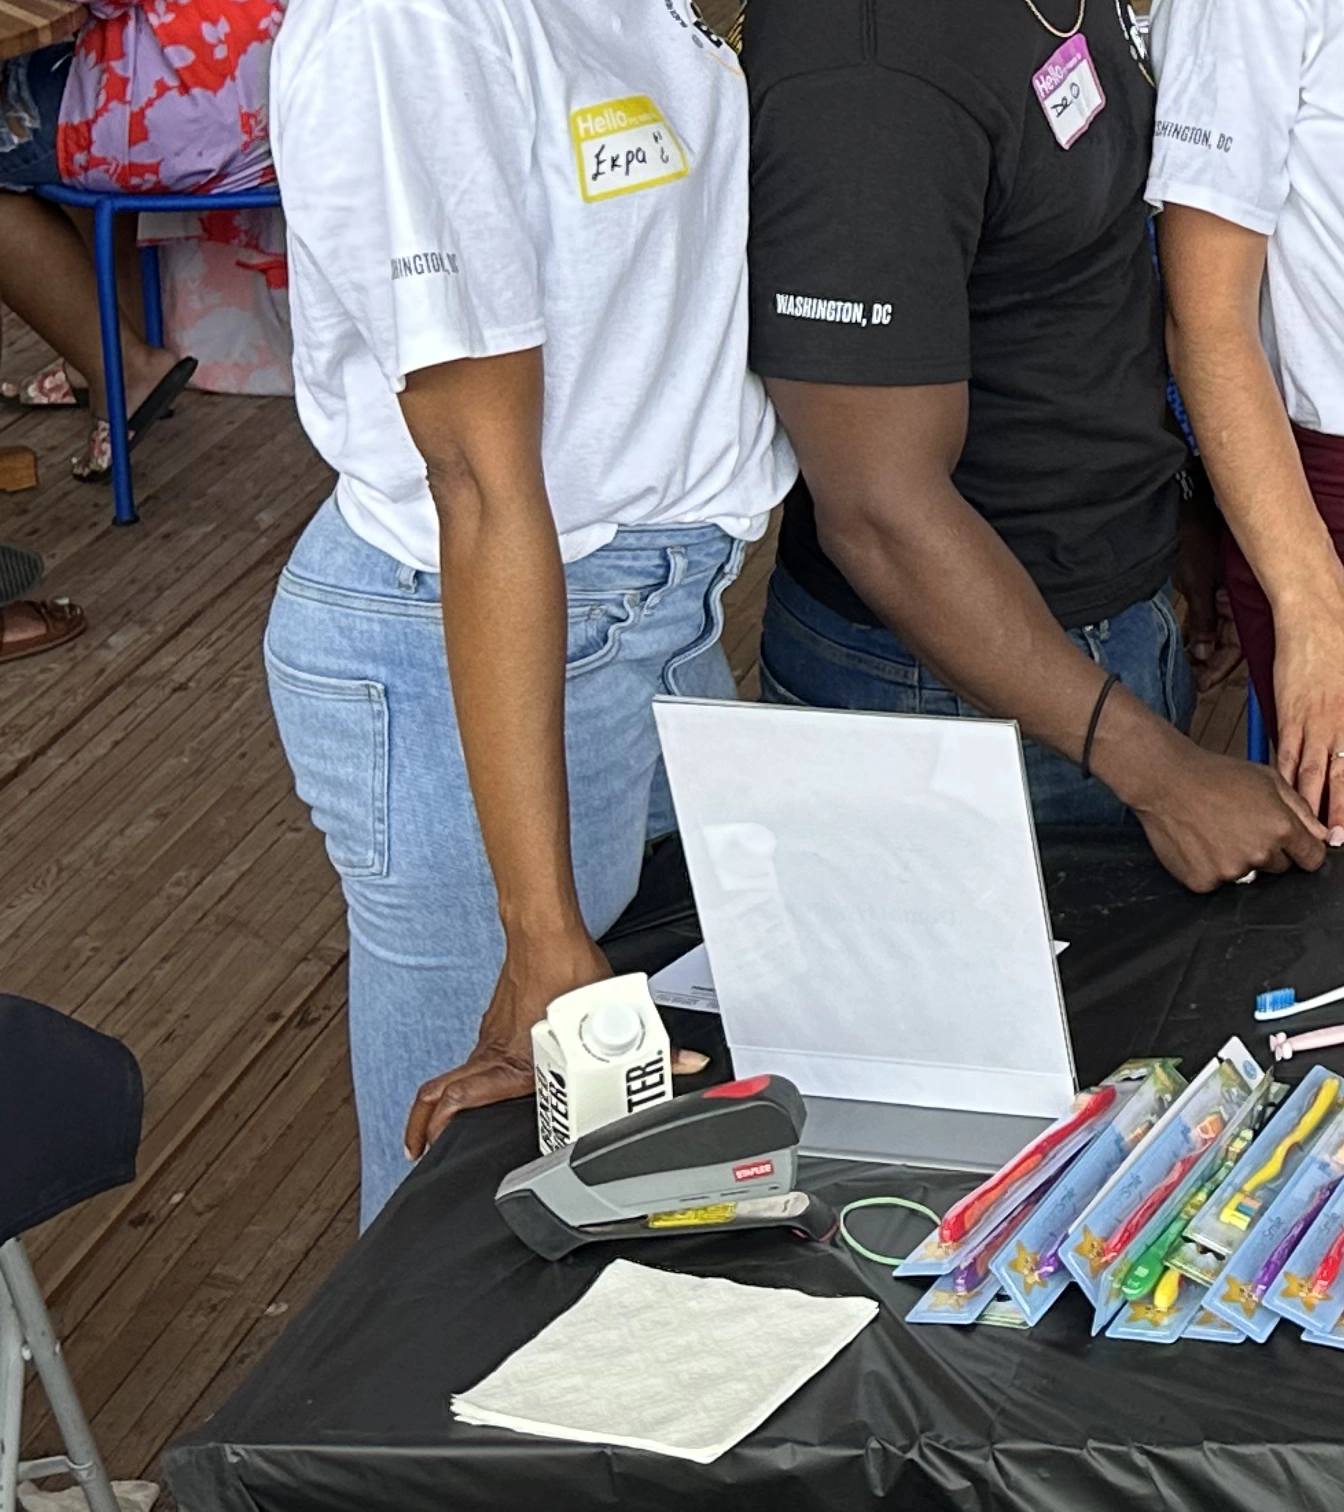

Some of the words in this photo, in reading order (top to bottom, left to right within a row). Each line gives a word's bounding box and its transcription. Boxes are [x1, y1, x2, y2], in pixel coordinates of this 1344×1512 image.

[1035, 65, 1063, 98] Hello
[576, 107, 628, 140] Hello
[1216, 133, 1234, 153] DC
[776, 293, 868, 328] WASHINGTON,
[871, 303, 893, 325] DC
[627, 1049, 667, 1114] TER.
